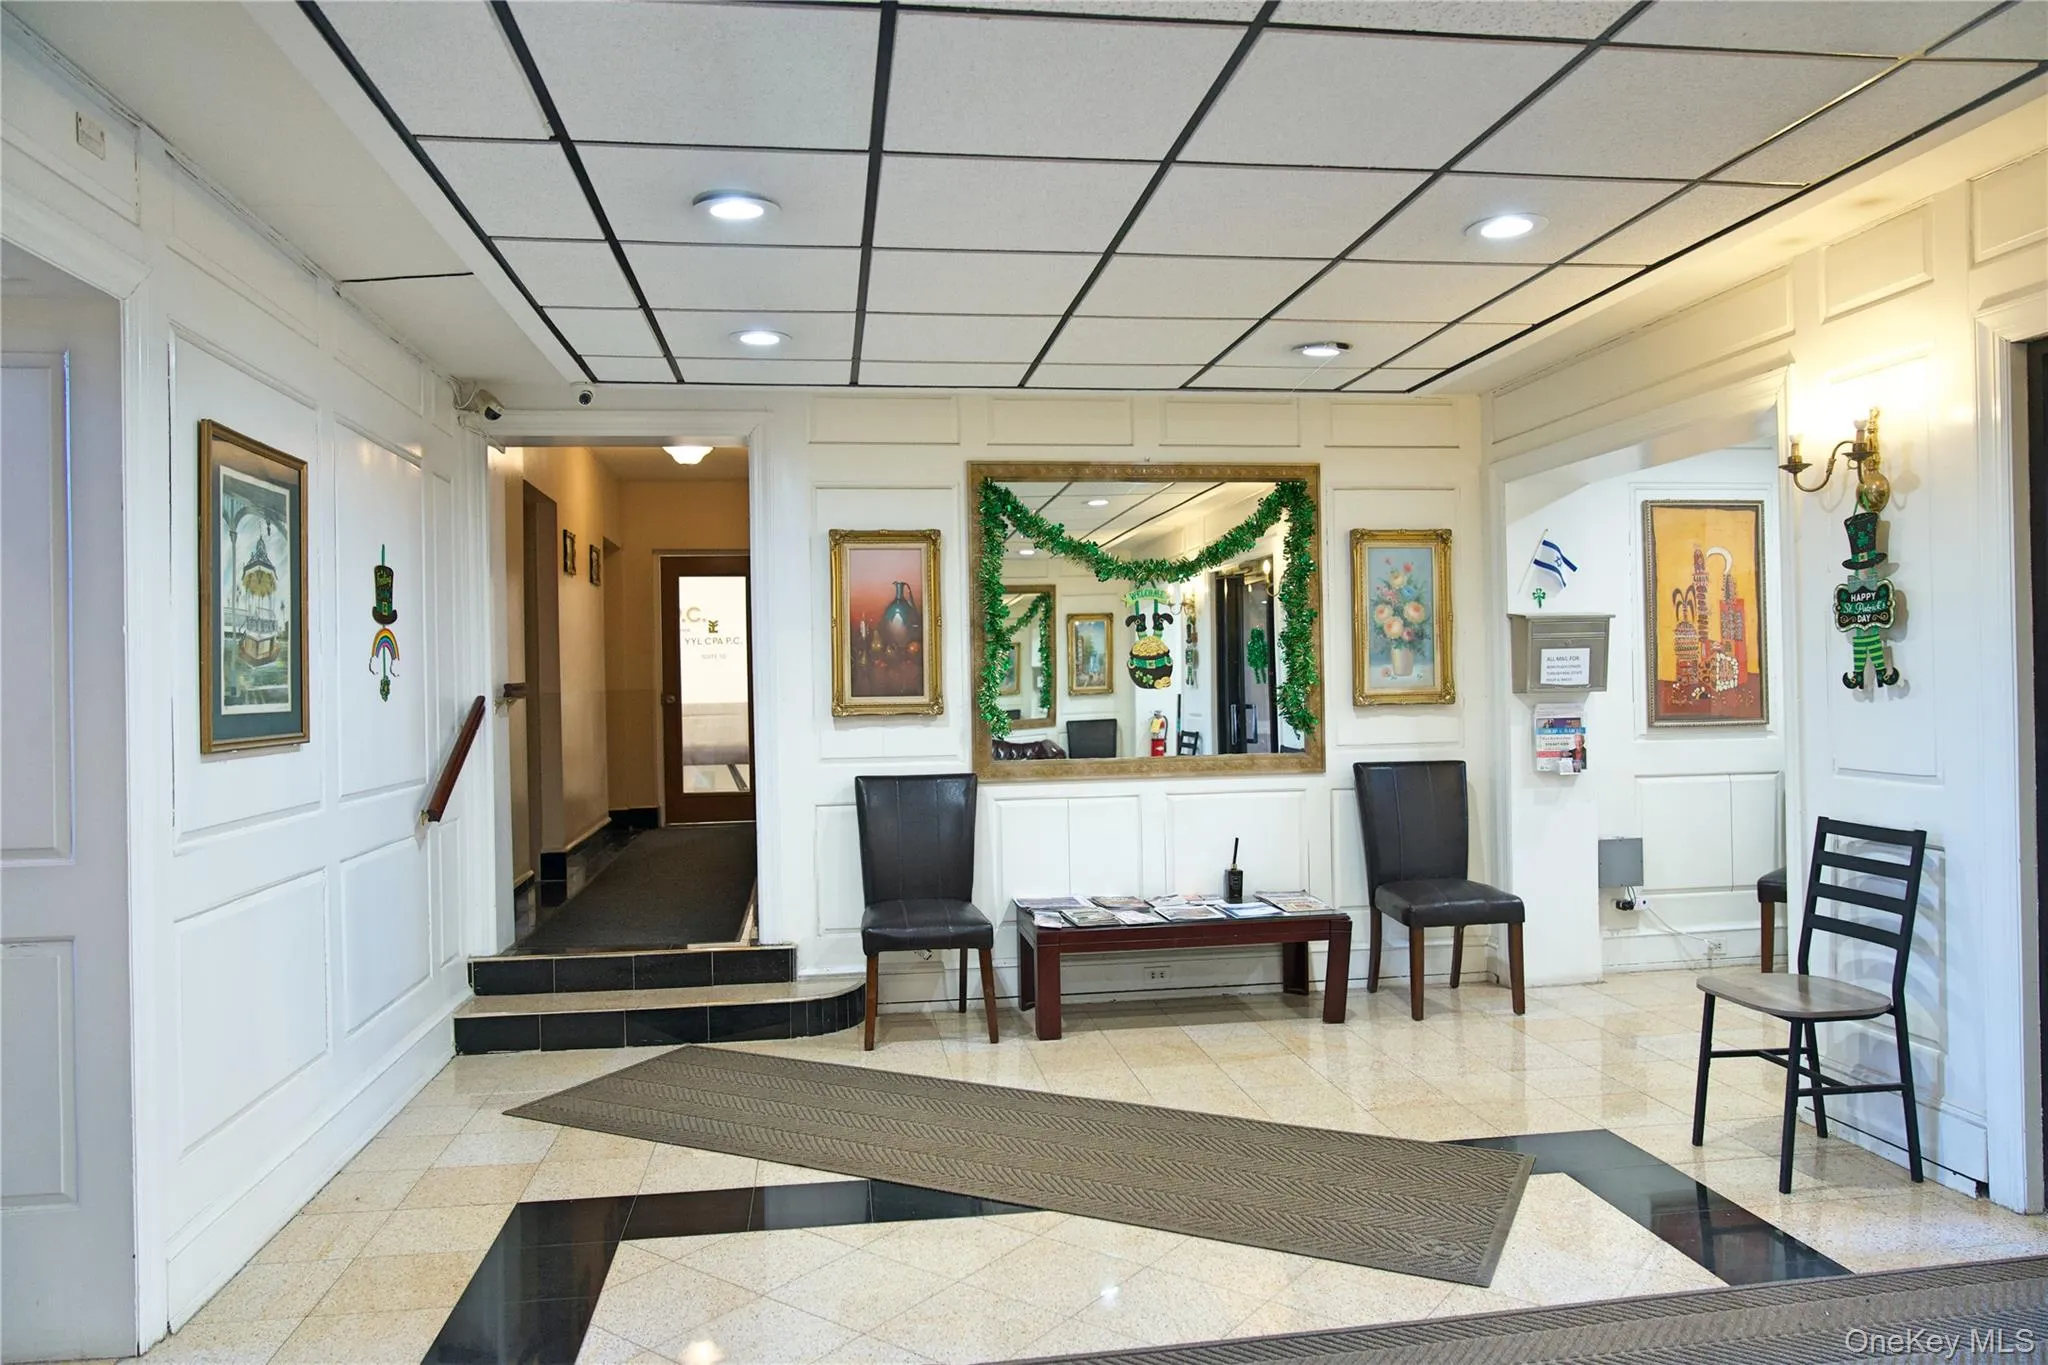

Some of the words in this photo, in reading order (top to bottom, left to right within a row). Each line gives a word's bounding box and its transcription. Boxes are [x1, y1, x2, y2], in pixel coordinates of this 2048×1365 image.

[1850, 592, 1877, 603] HAPPY
[1857, 614, 1872, 623] DAY
[684, 637, 703, 646] YYL
[704, 637, 724, 646] CPA
[725, 637, 744, 646] P.C.
